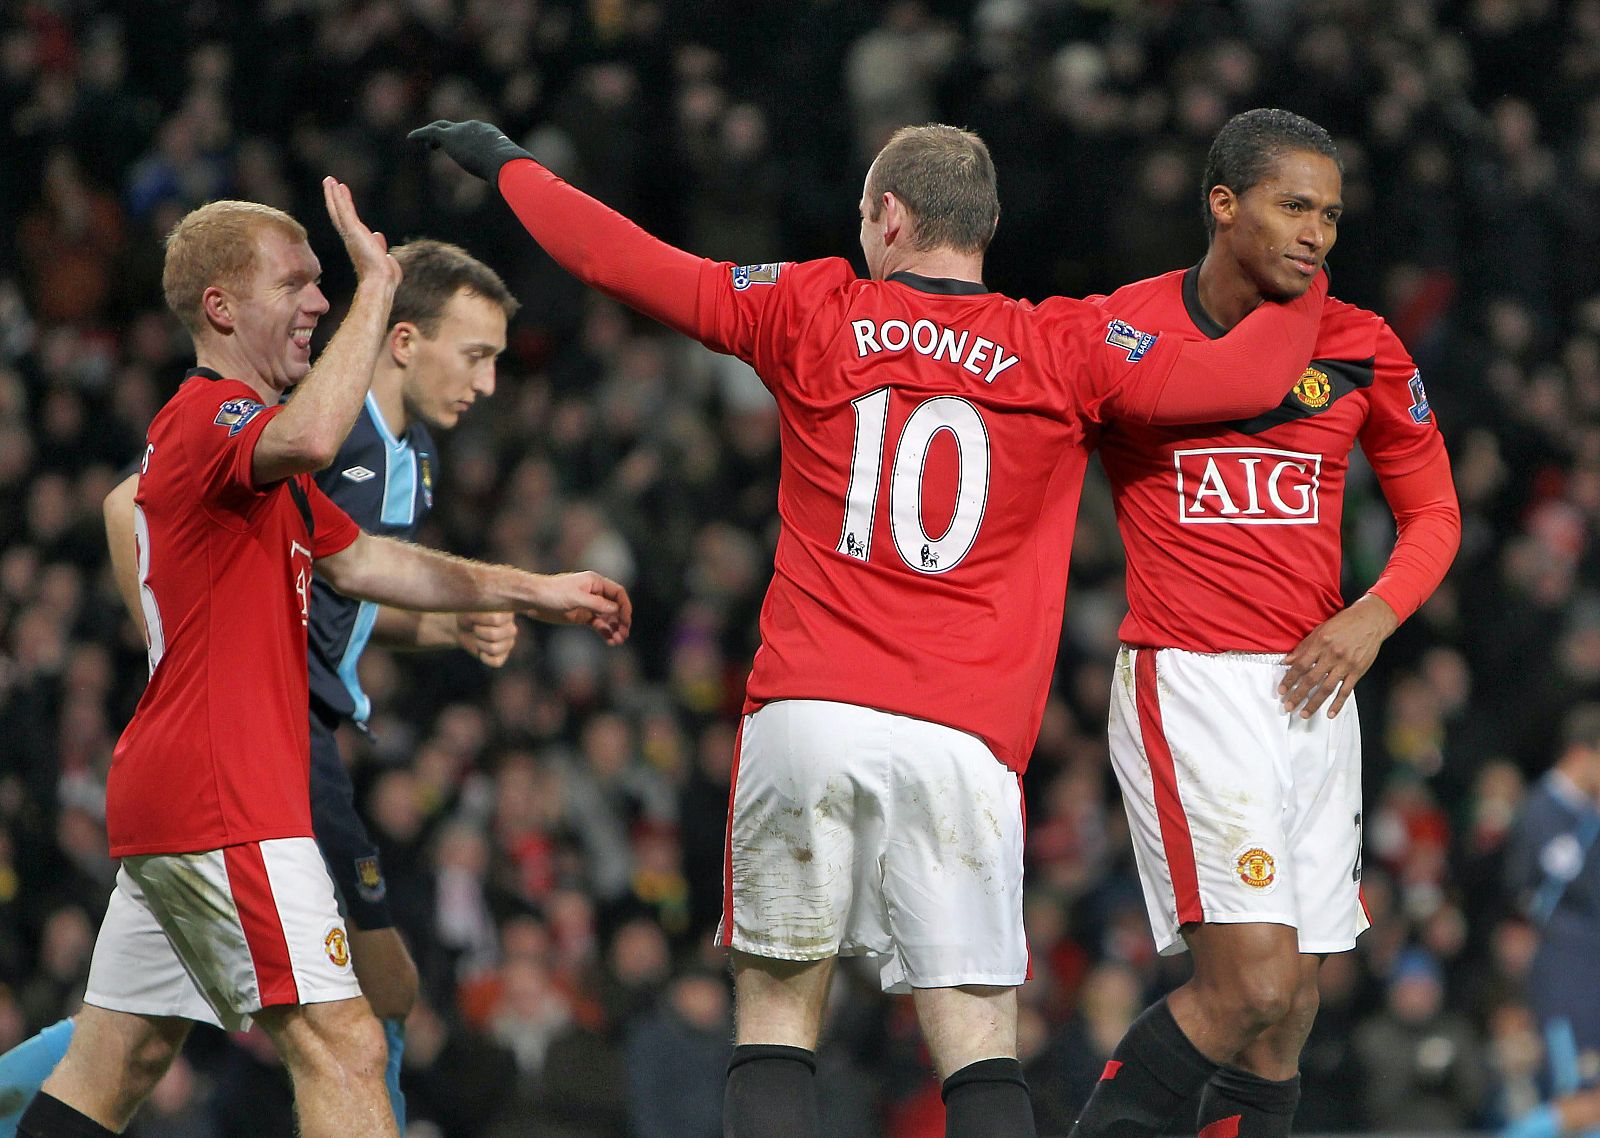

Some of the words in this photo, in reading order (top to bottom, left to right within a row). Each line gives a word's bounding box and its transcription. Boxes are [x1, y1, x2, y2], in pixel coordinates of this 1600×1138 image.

[851, 319, 1020, 384] ROONEY
[835, 385, 991, 575] 10
[1189, 456, 1311, 515] AIG
[1247, 879, 1271, 887] UNITED
